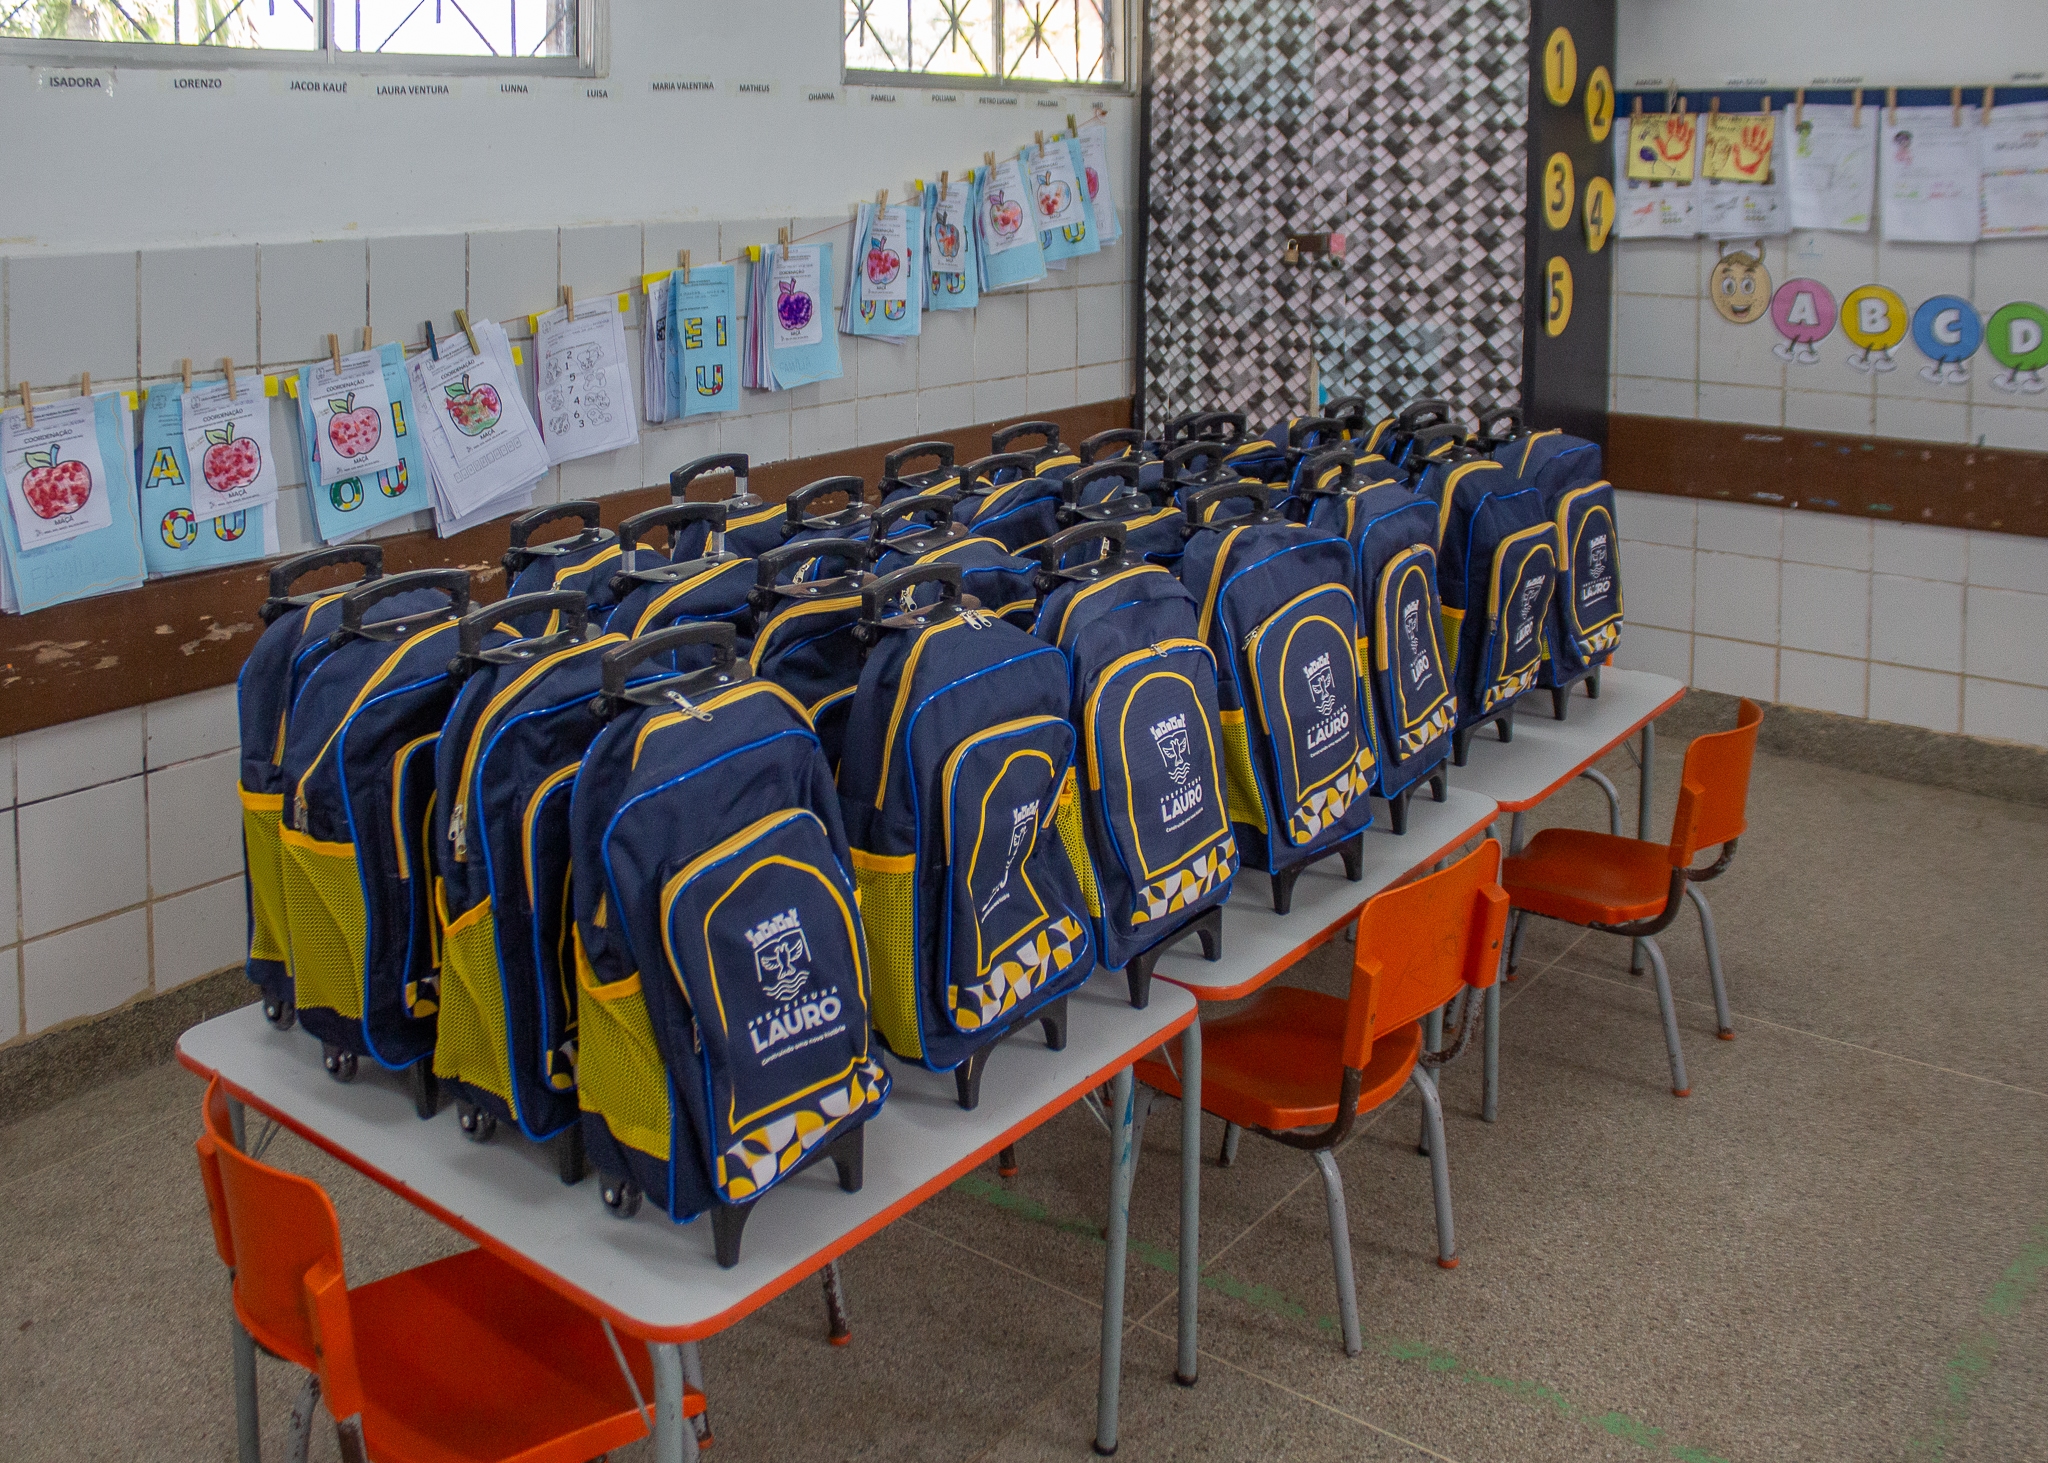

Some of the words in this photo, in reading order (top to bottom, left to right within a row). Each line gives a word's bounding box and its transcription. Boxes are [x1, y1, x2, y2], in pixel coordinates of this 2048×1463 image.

[1554, 40, 1565, 89] 1
[49, 76, 102, 88] ISADORA
[173, 78, 222, 89] LORENZO
[289, 80, 321, 91] JACOB
[500, 83, 529, 94] LUNNA
[652, 82, 675, 91] MARIA
[676, 81, 714, 90] VALENTINA
[739, 83, 770, 92] MATHEUS
[376, 85, 407, 95] LAURA
[408, 84, 450, 95] VENTURA
[586, 89, 608, 98] LUISA
[1593, 79, 1607, 127] 2
[1551, 162, 1567, 212] 3
[1590, 189, 1604, 237] 4
[1550, 271, 1564, 321] 5
[1787, 291, 1820, 326] A
[1858, 297, 1892, 334] B
[1932, 308, 1962, 345] C
[2009, 318, 2042, 354] D
[684, 317, 703, 349] E
[566, 351, 573, 360] 2
[569, 374, 576, 382] 5
[696, 364, 724, 396] U
[567, 386, 574, 395] 7
[573, 396, 580, 405] 4
[203, 408, 243, 422] COORDENAÇÃO
[573, 411, 580, 419] 6
[578, 420, 585, 428] 3
[24, 429, 73, 444] COORDENAÇÃO
[146, 446, 185, 489] A
[161, 508, 198, 549] O
[1307, 711, 1349, 750] LAURO
[1161, 784, 1202, 823] LAURO
[748, 985, 838, 1029] PREFEITURA
[750, 996, 842, 1054] LAURO
